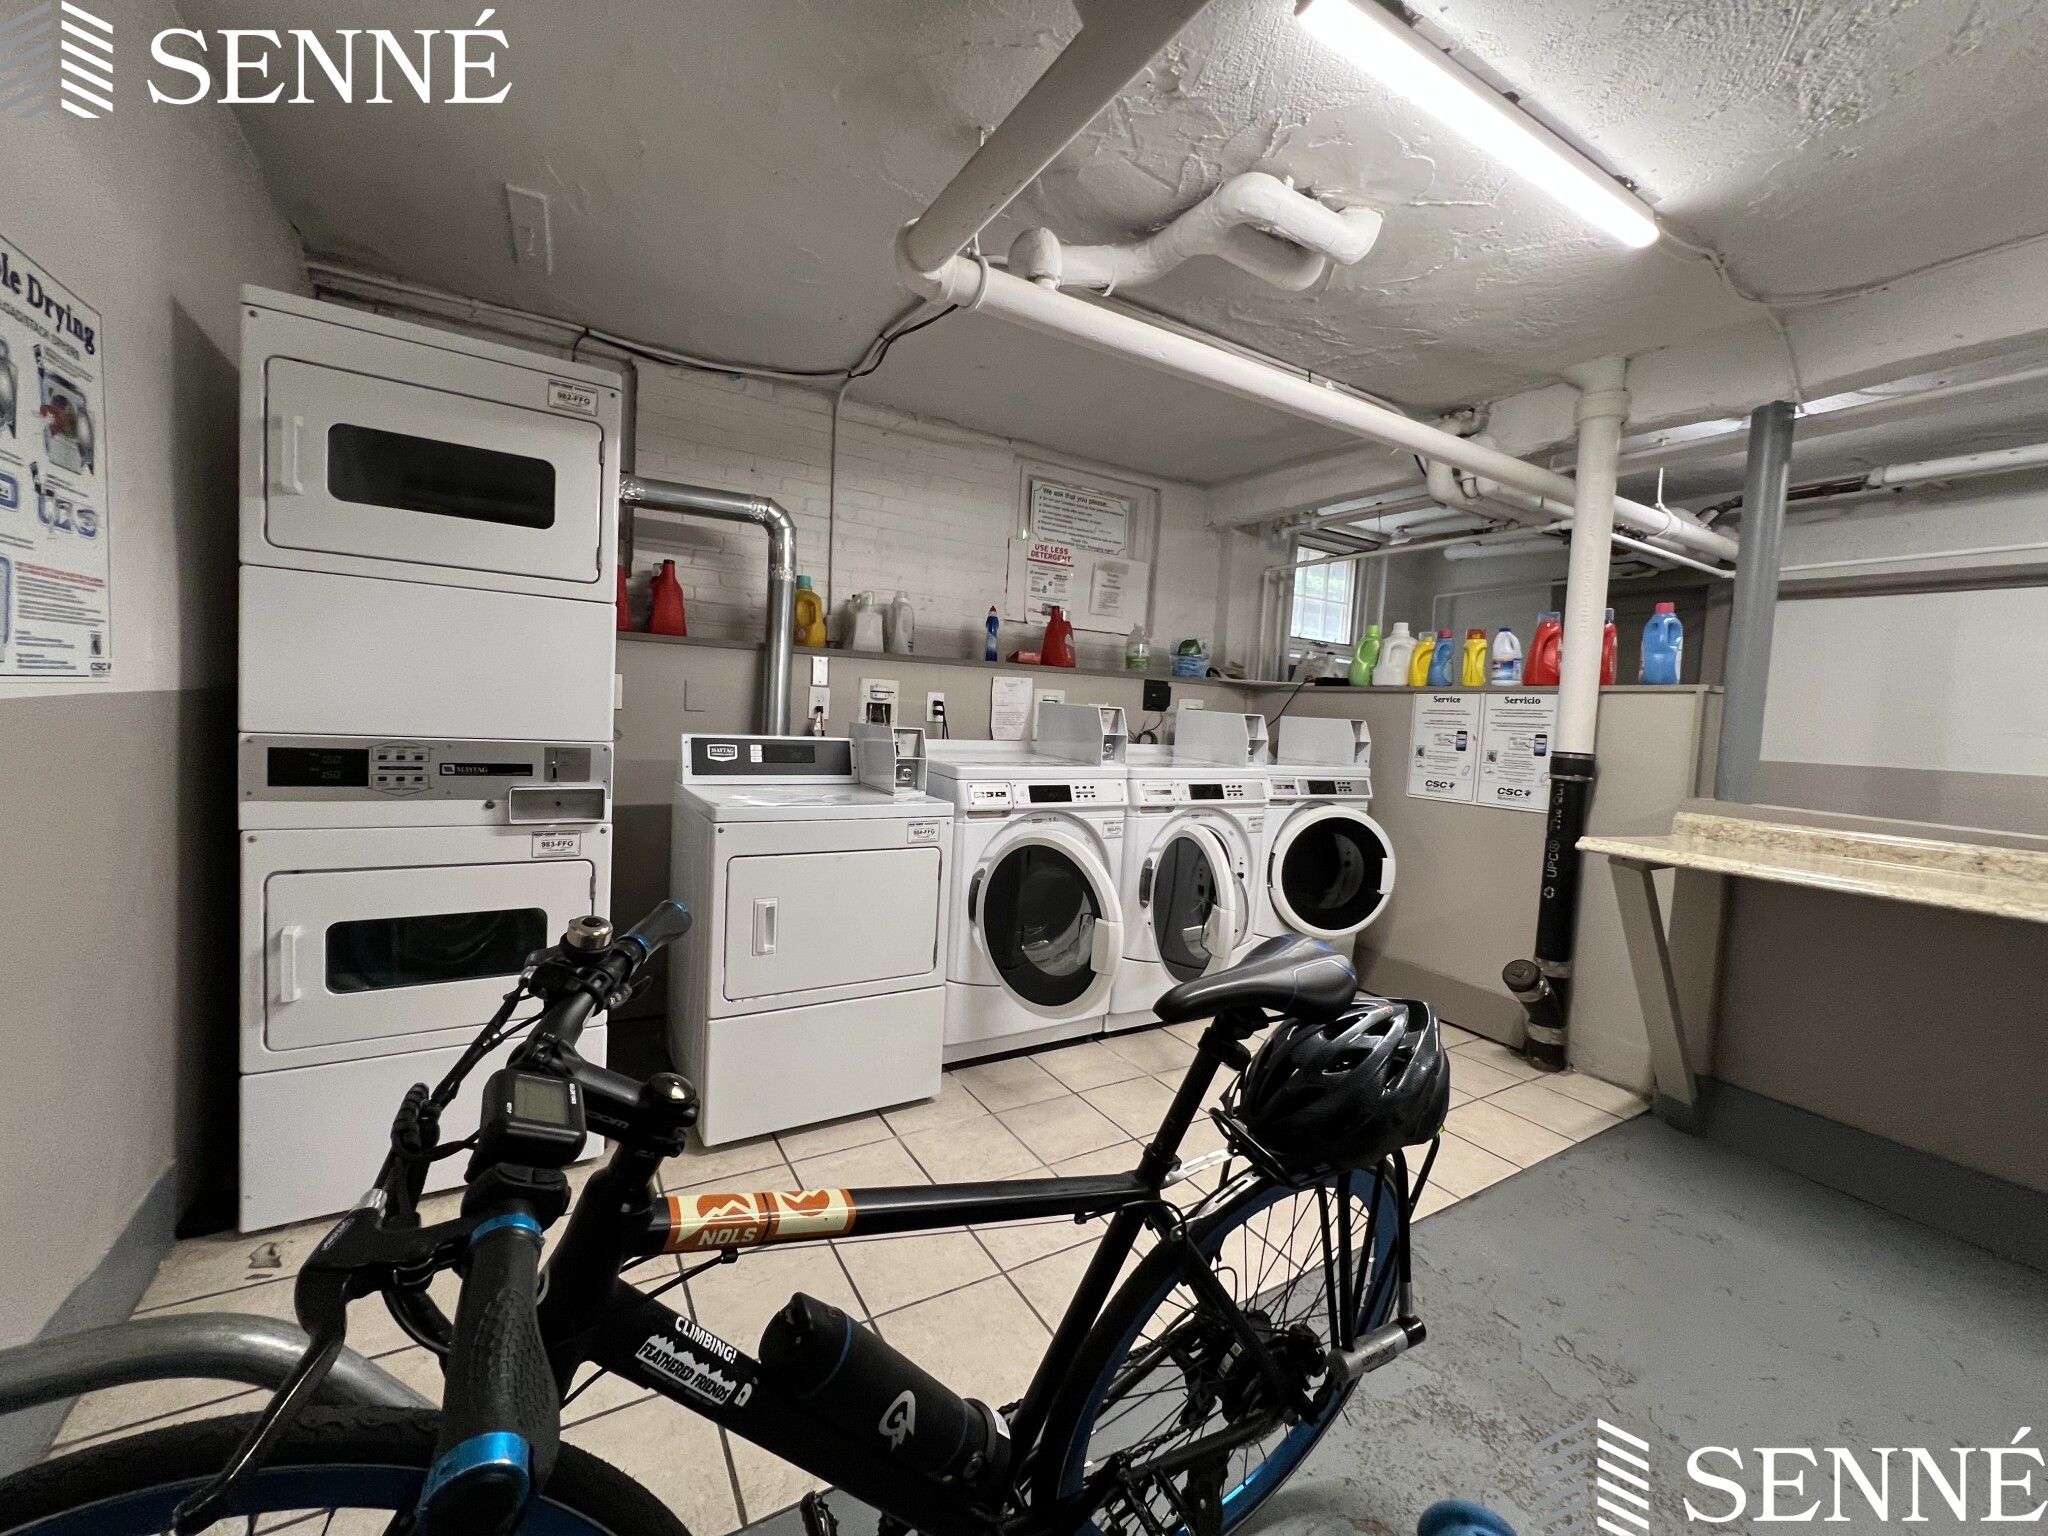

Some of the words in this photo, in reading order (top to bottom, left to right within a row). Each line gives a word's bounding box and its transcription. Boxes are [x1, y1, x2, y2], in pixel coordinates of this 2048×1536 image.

[0, 252, 21, 295] le
[26, 273, 95, 355] Drying
[1043, 487, 1052, 495] We
[1065, 491, 1075, 500] that
[1077, 496, 1087, 504] you
[1034, 543, 1048, 552] USE
[1051, 546, 1068, 555] LESS
[1030, 550, 1071, 562] DETERGENT
[1433, 695, 1461, 704] Service
[1504, 696, 1541, 705] Servicio
[1425, 780, 1447, 789] CSC
[1497, 787, 1523, 797] CSC
[541, 840, 574, 848] 983-FFG
[698, 1227, 758, 1246] NOLS
[674, 1316, 738, 1364] CLIMBING!
[638, 1342, 695, 1381] FEATHERED
[690, 1372, 731, 1402] FRIENDS
